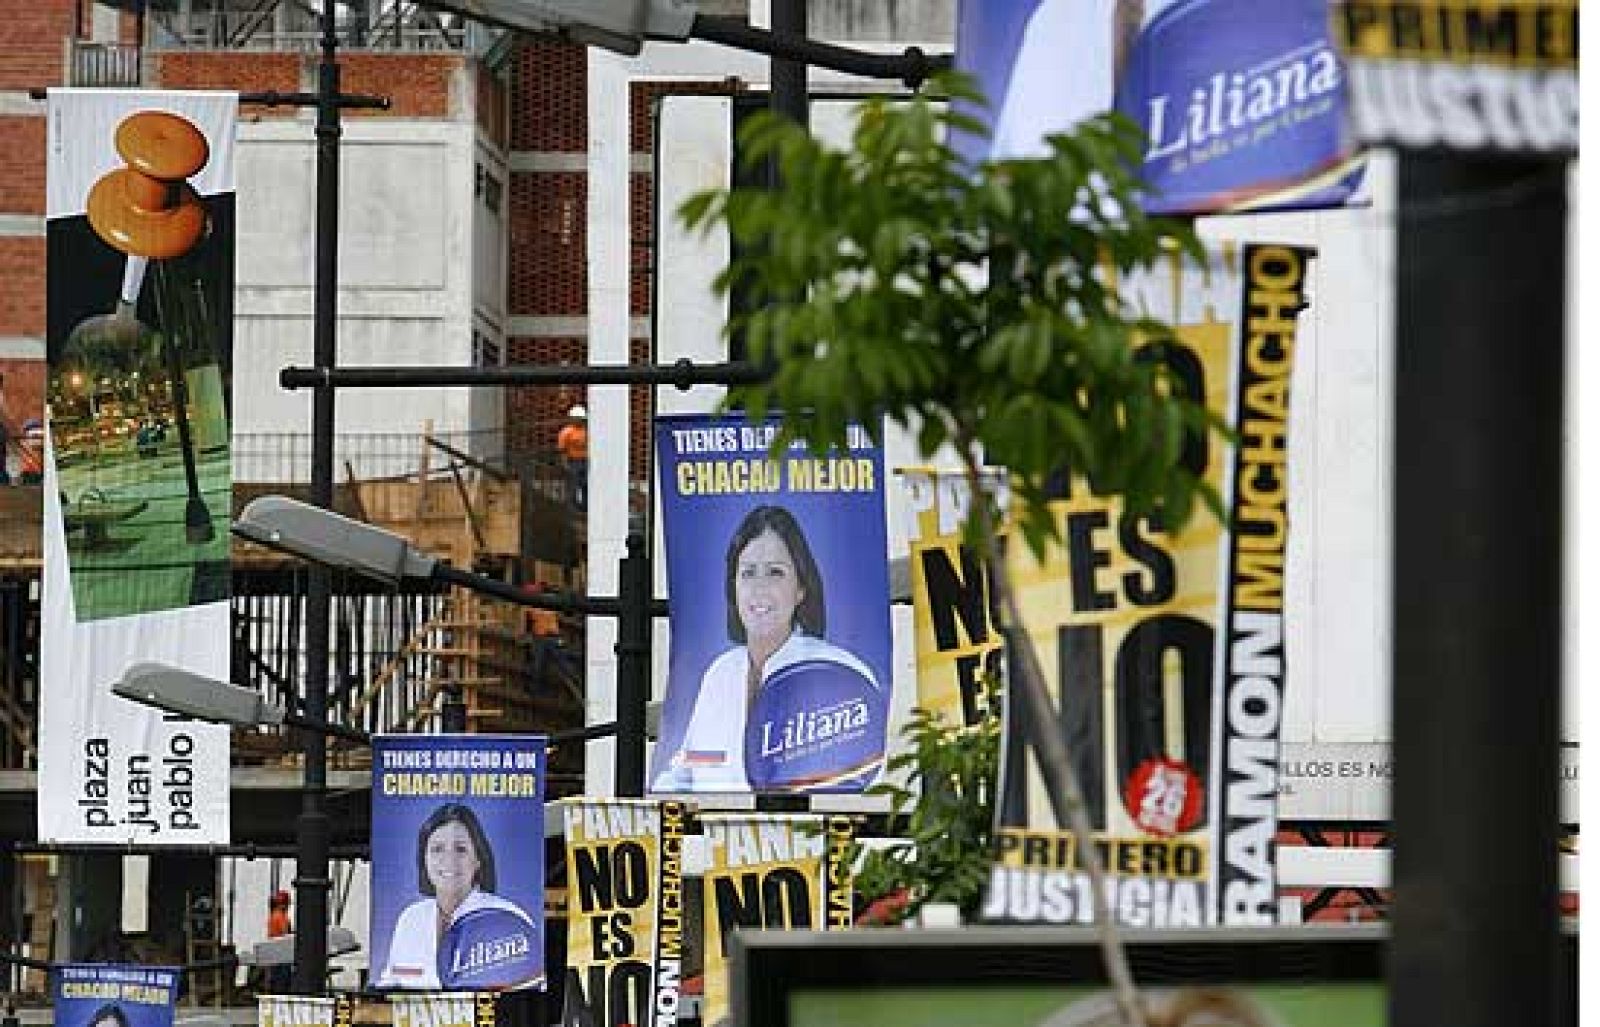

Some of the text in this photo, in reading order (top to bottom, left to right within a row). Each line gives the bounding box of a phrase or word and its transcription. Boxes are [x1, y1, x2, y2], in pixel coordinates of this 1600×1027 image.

[1346, 3, 1580, 56] PRIME
[1144, 50, 1338, 163] Liliana
[674, 427, 737, 454] TIENES
[677, 458, 875, 495] CHACAO MEJOR
[921, 534, 1005, 652] N
[1066, 506, 1177, 613] ES
[1224, 248, 1302, 926] RAMON MUCHACHO
[761, 703, 868, 757] Liliana
[1000, 613, 1216, 832] NO
[78, 738, 117, 827] plaza
[119, 755, 161, 834] juan
[162, 732, 201, 830] pablo
[384, 774, 536, 796] CHACAO MEJOR
[564, 802, 659, 842] PANA
[703, 818, 823, 866] PANA
[571, 841, 650, 912] NO
[658, 800, 682, 957] MUCHACHO
[714, 866, 814, 958] NO
[453, 936, 530, 973] Liliana
[591, 913, 636, 961] ES
[563, 961, 652, 1027] NO
